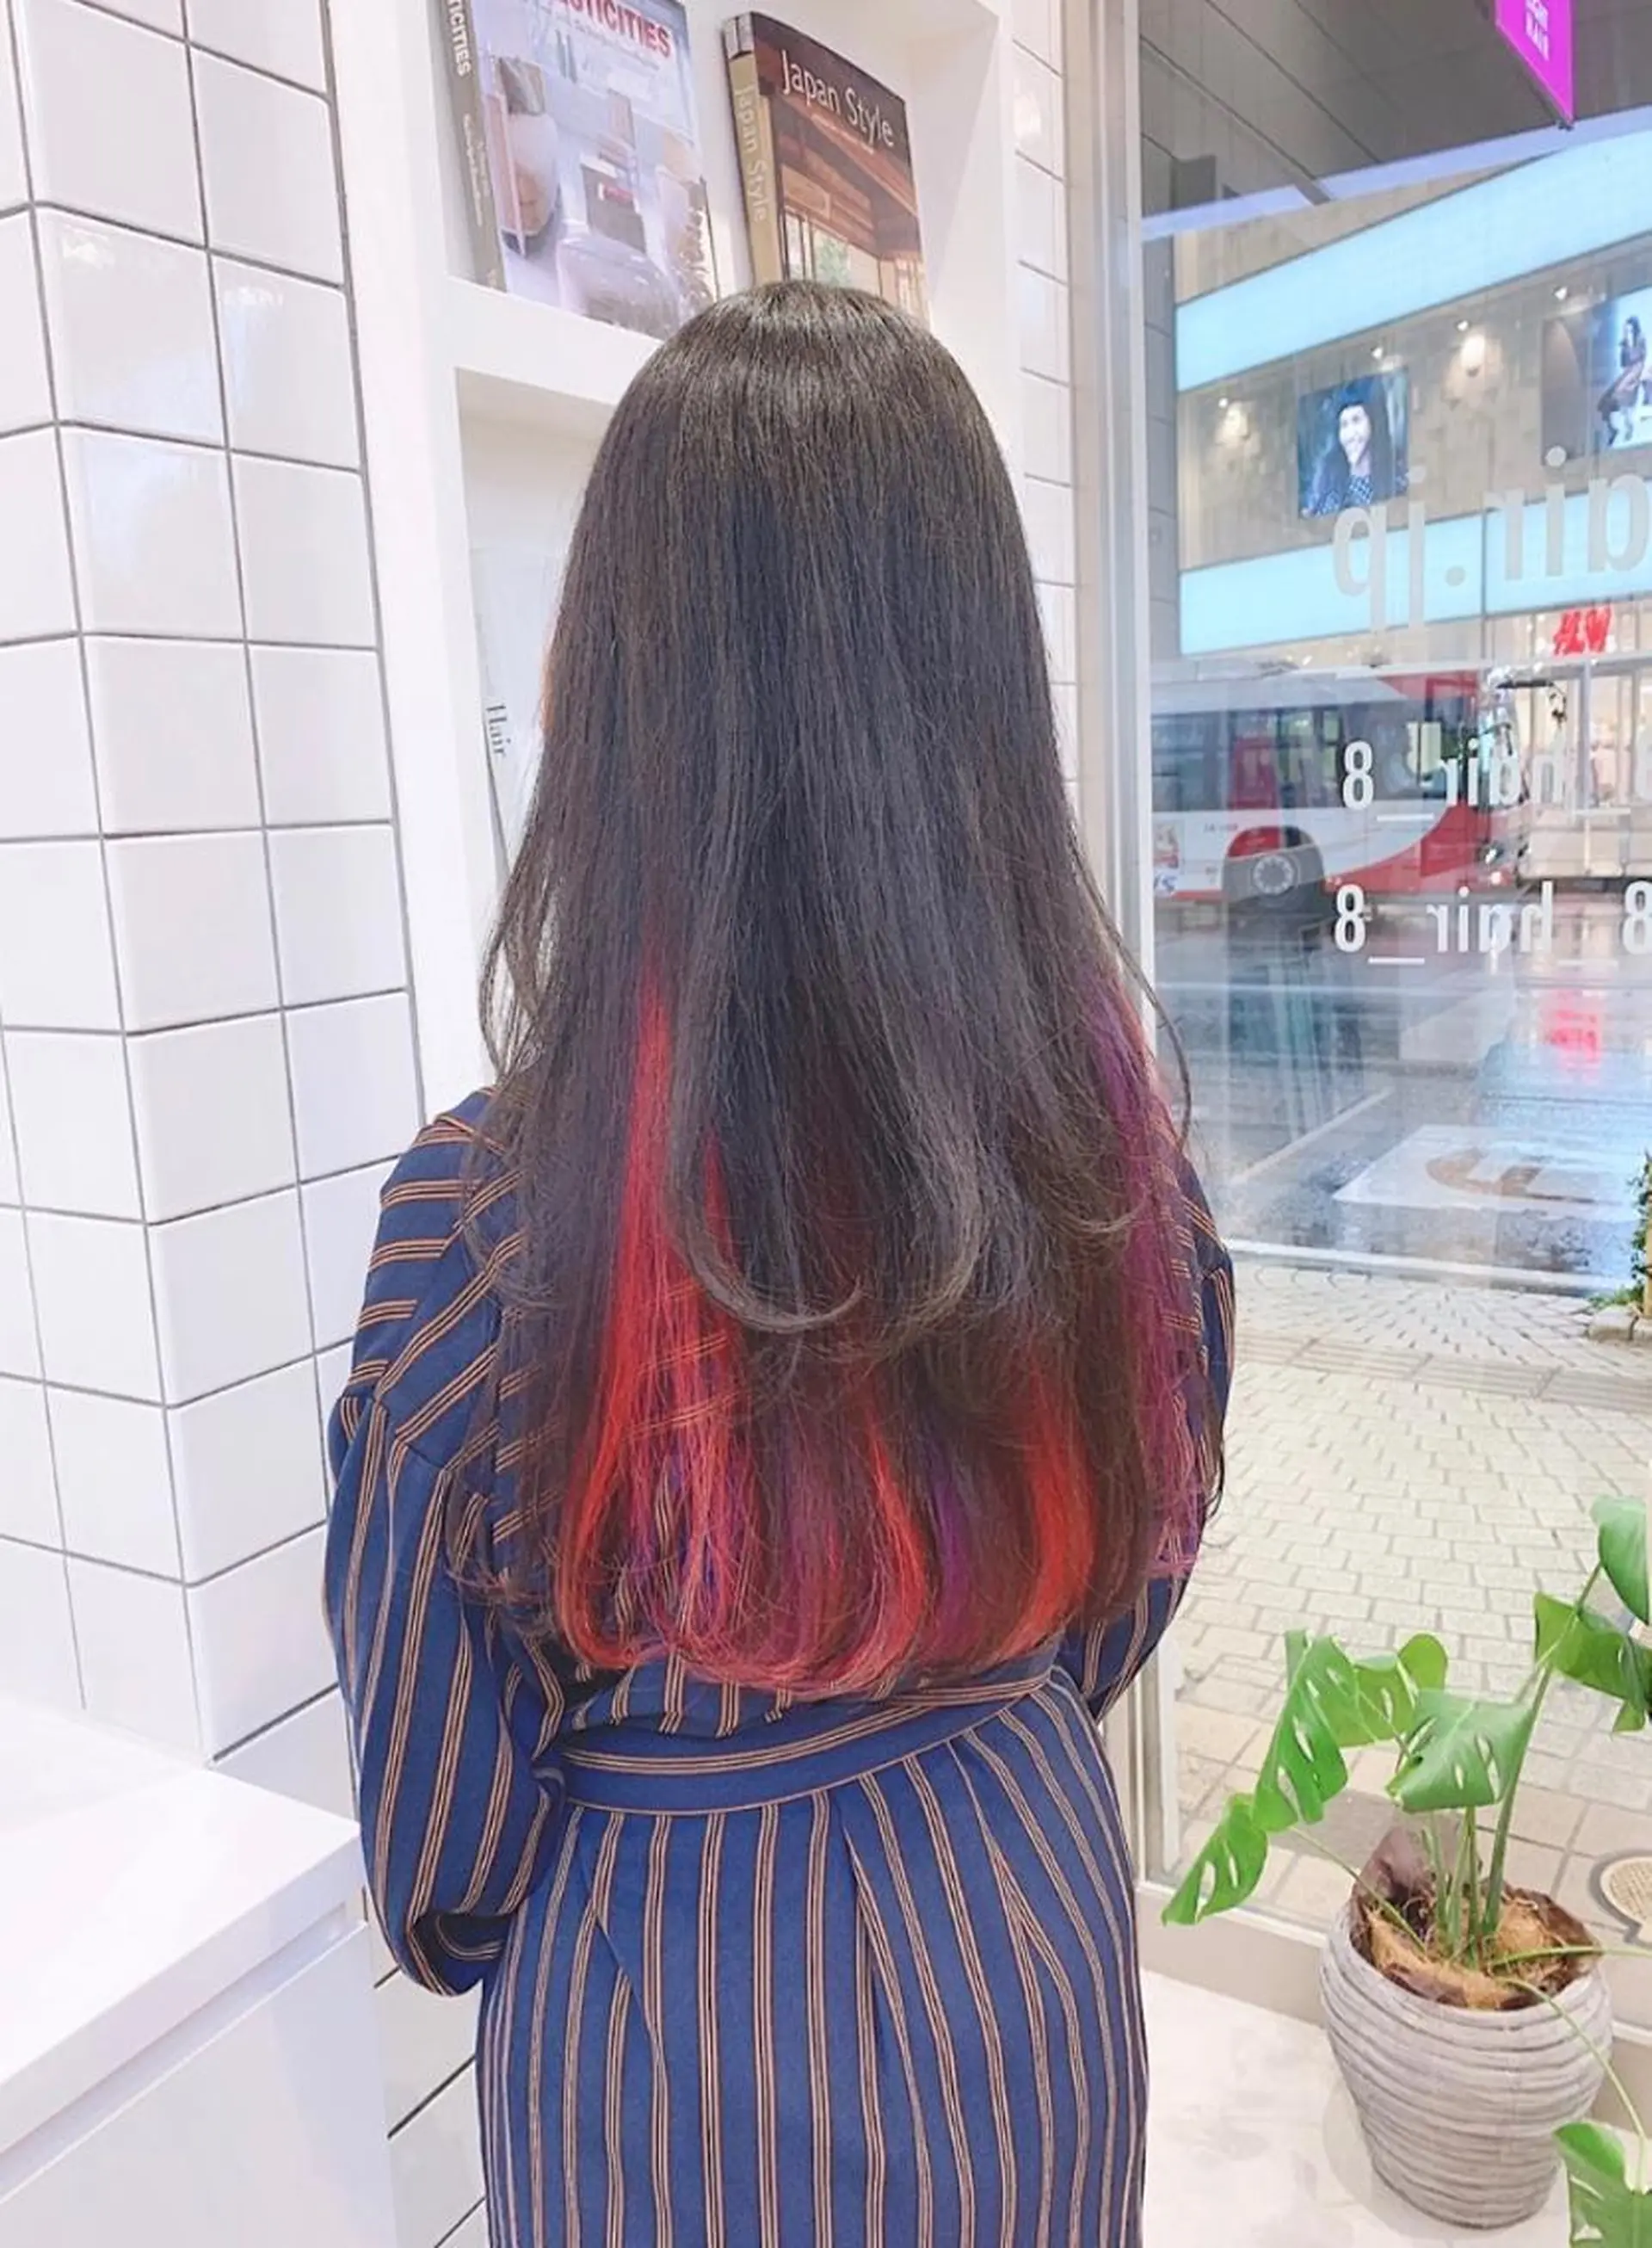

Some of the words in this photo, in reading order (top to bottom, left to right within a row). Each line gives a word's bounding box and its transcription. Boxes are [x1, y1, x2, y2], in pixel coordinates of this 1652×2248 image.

[781, 49, 841, 114] Japan
[845, 87, 895, 151] Style
[733, 86, 758, 153] Japan
[746, 159, 769, 223] Style
[485, 703, 511, 758] Hair
